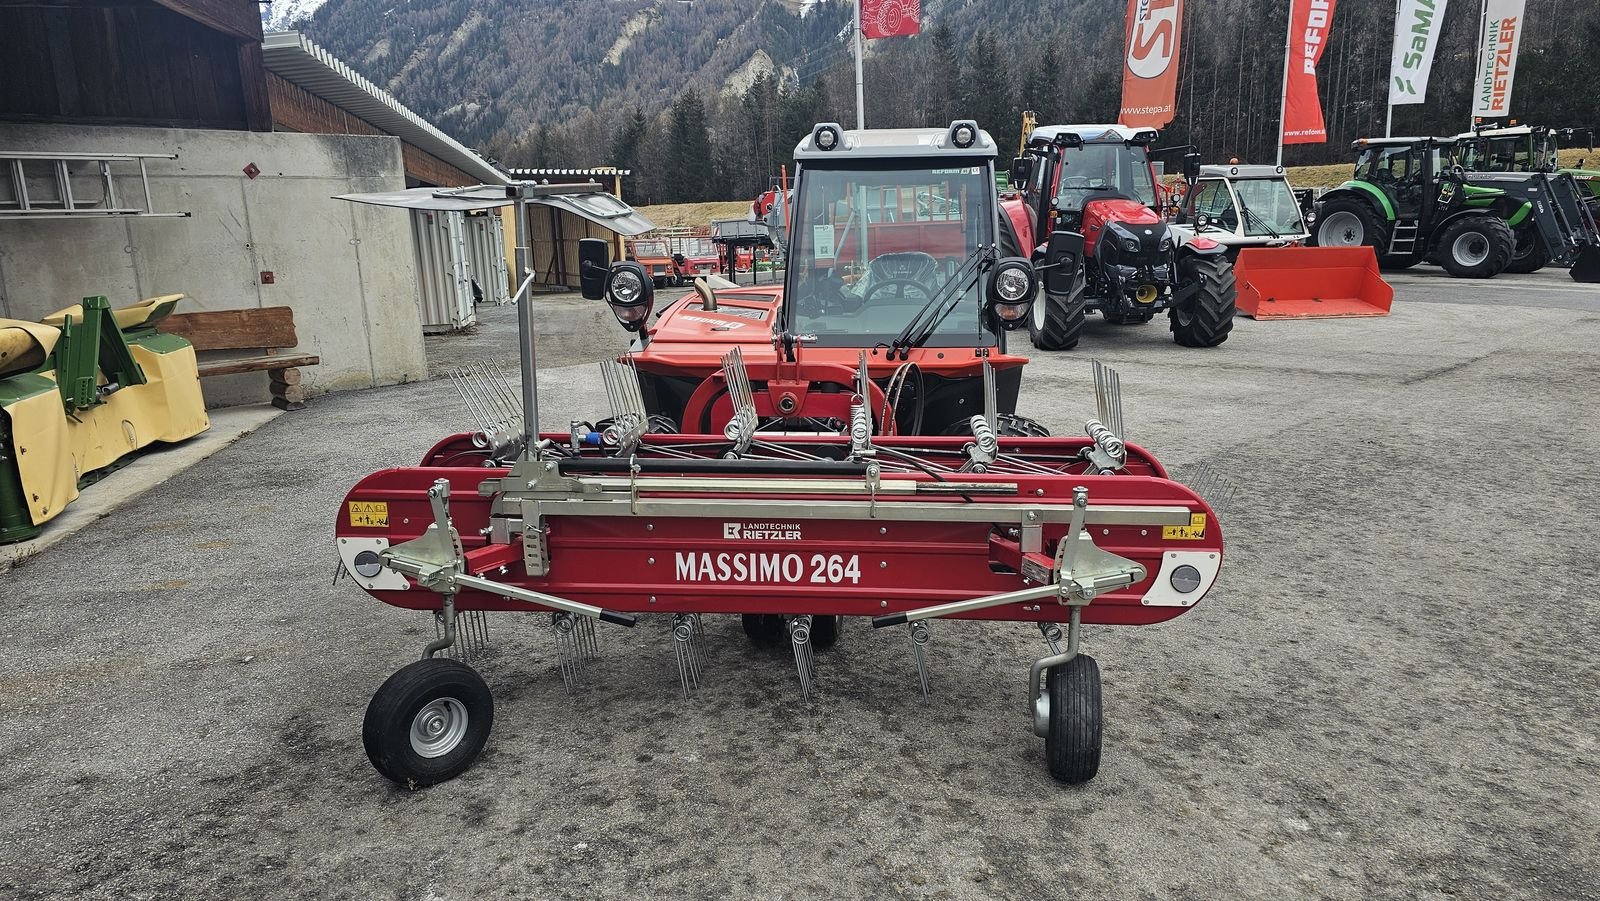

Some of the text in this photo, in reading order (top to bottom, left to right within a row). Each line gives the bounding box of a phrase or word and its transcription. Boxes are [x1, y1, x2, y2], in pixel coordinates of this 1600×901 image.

[1479, 19, 1500, 111] LANDTECHNIK
[1491, 16, 1518, 111] RIETZLER
[1121, 104, 1171, 115] www.stepa.at
[743, 530, 801, 540] RIETZLER
[675, 552, 861, 584] MASSIMO 264
